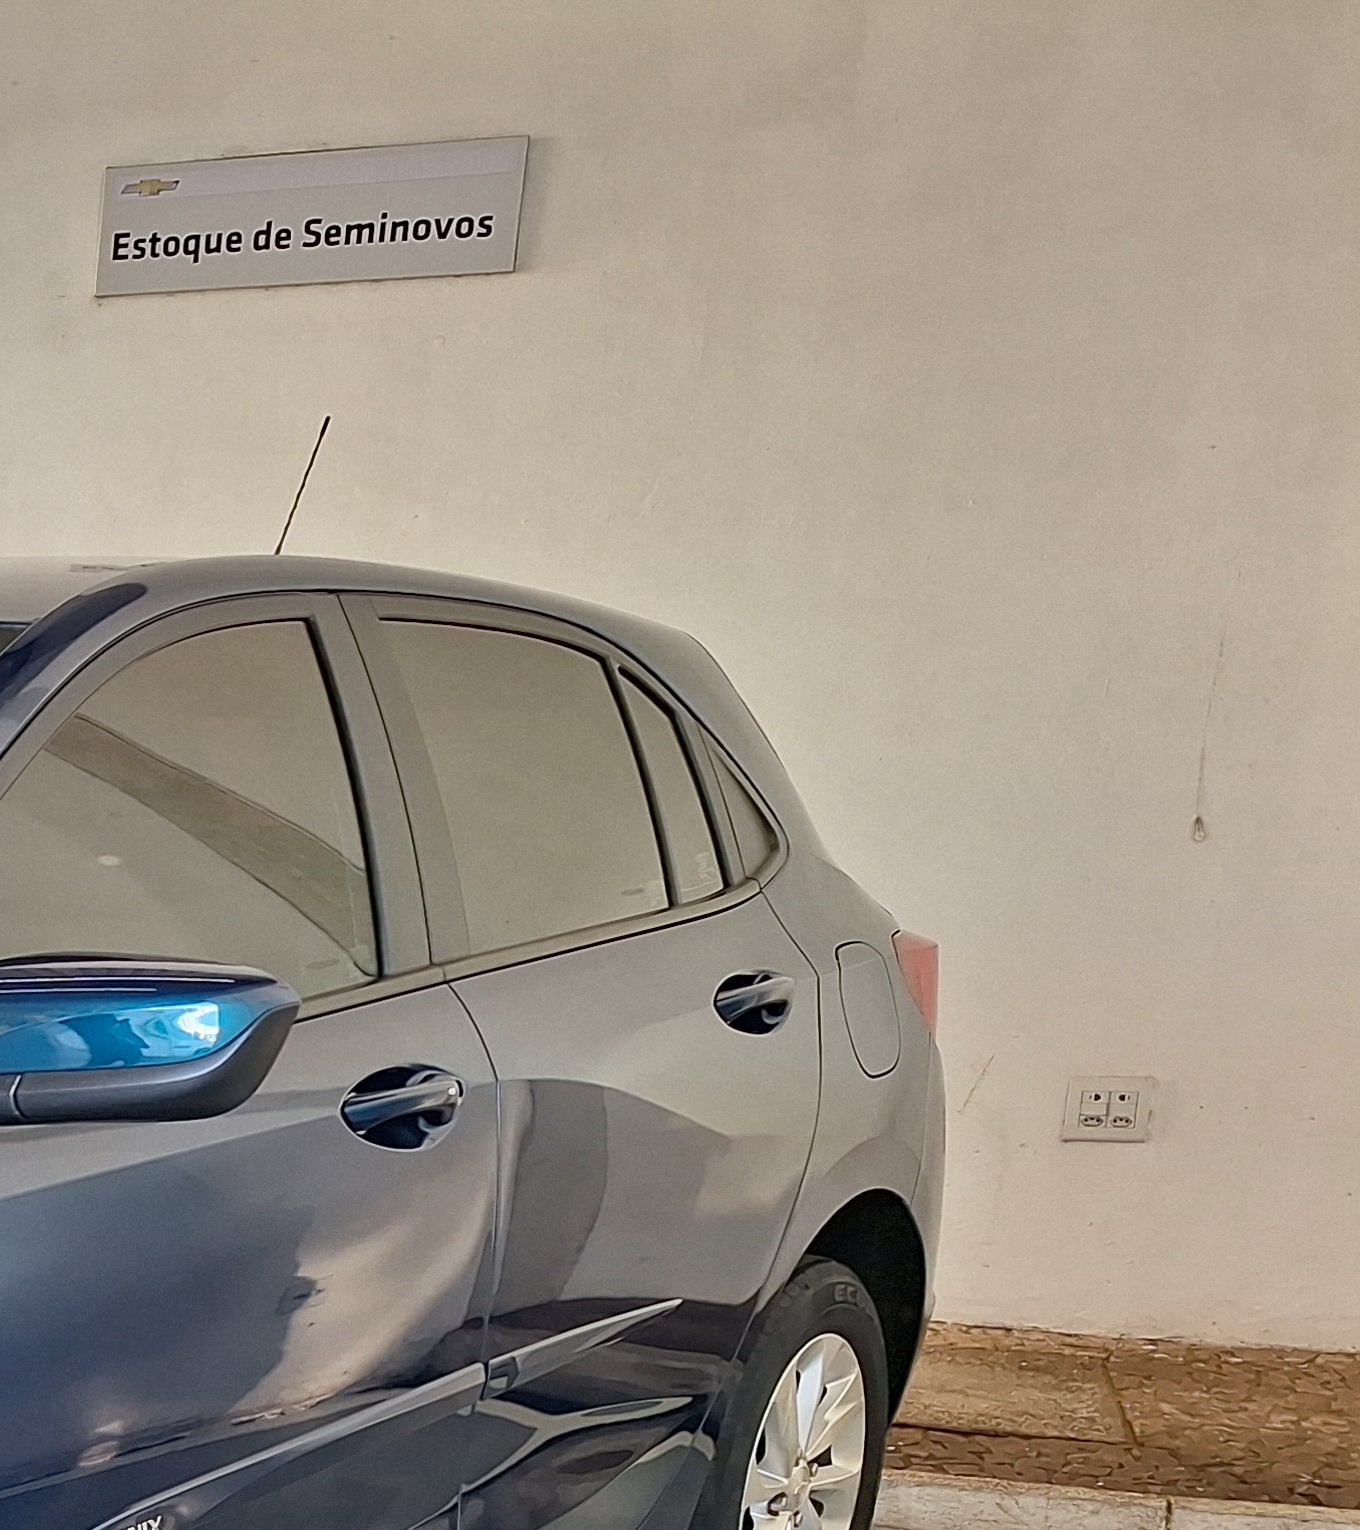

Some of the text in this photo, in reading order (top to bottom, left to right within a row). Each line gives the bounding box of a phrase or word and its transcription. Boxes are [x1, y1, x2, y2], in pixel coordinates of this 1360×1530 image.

[111, 212, 495, 264] Estoque de Seminovos
